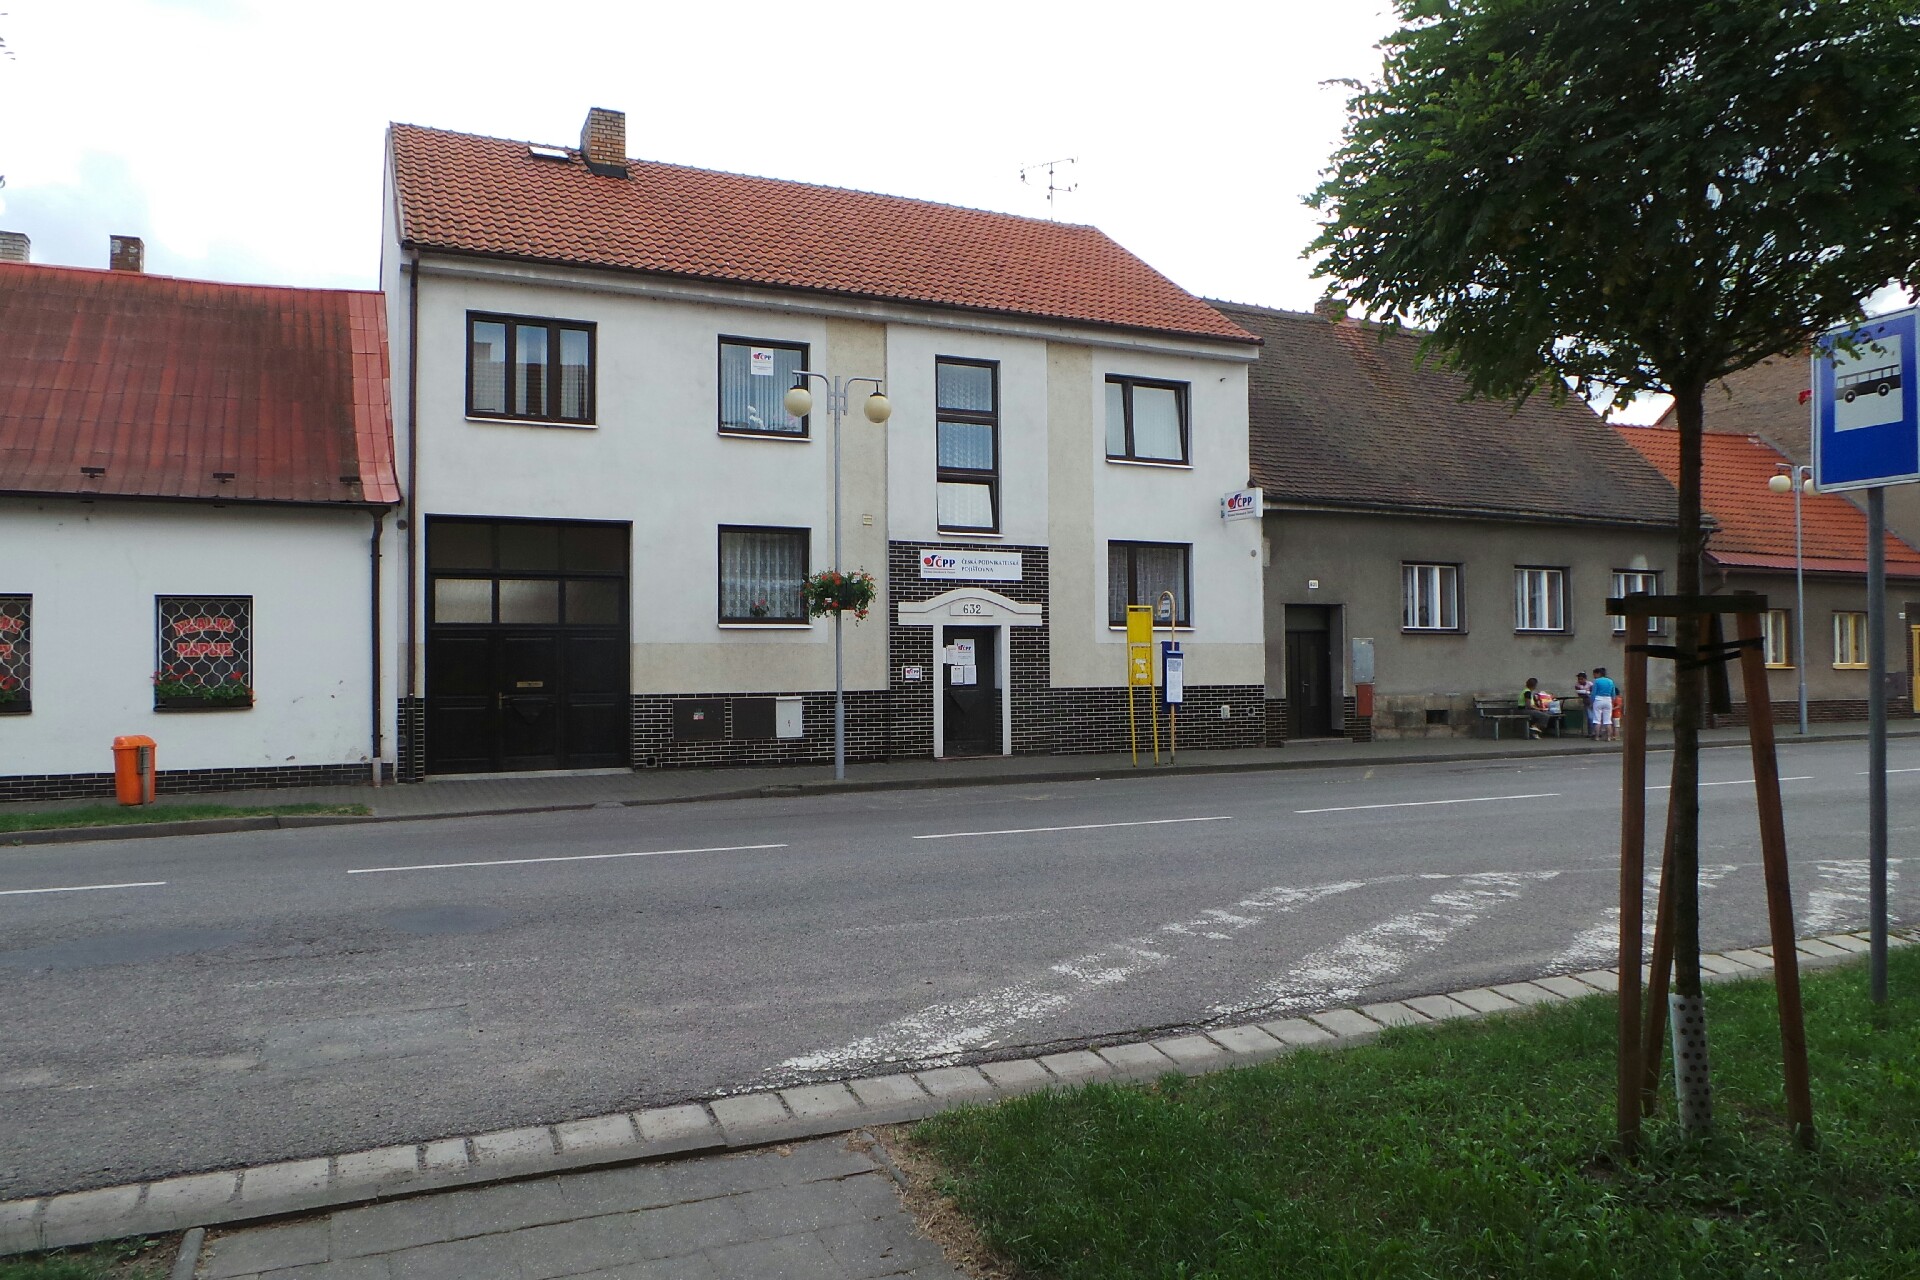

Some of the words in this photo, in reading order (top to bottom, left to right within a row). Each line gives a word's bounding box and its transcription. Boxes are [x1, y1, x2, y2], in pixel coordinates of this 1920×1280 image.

[1237, 495, 1252, 508] ČPP
[935, 556, 955, 567] ČPP
[963, 604, 982, 614] 632
